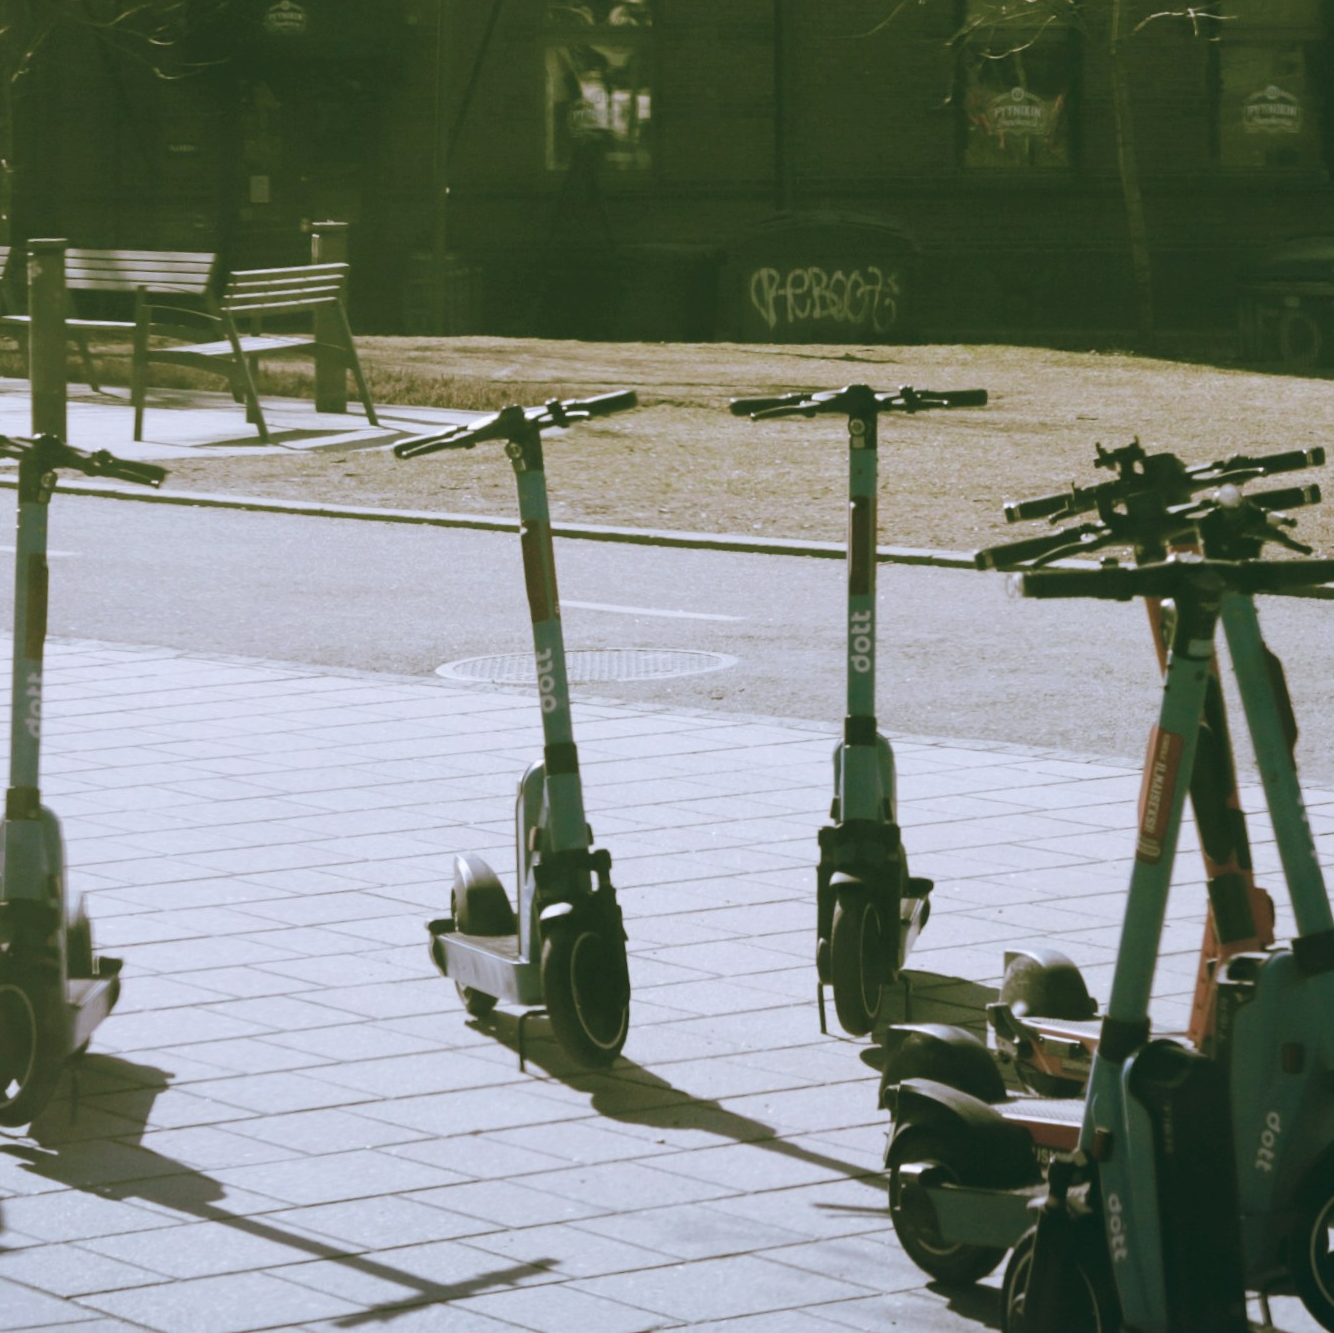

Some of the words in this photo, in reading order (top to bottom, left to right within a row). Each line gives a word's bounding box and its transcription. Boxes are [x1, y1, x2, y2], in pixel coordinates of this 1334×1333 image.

[850, 610, 871, 673] dott
[1255, 1111, 1281, 1172] dott
[1108, 1193, 1128, 1263] dott
